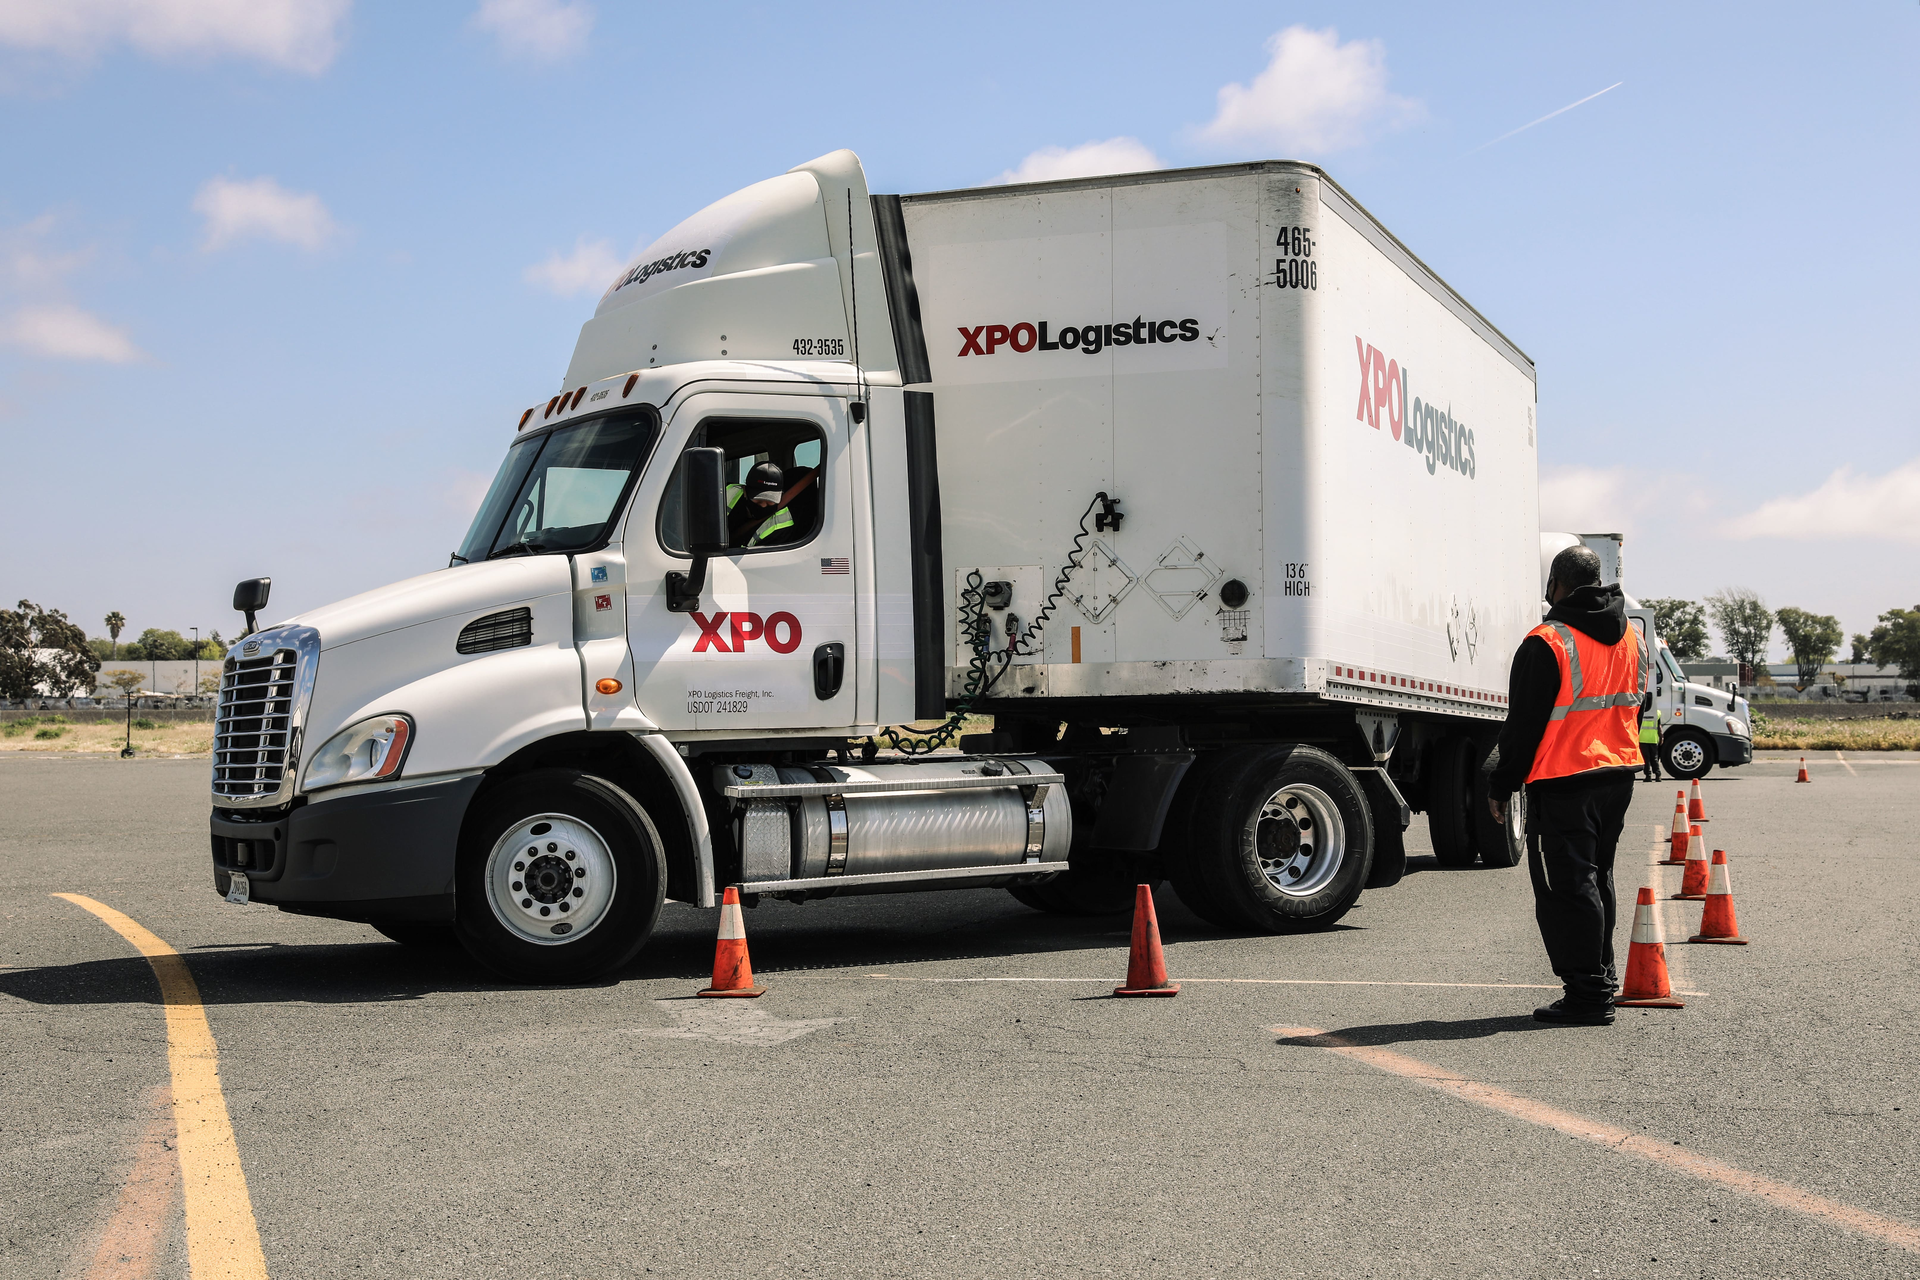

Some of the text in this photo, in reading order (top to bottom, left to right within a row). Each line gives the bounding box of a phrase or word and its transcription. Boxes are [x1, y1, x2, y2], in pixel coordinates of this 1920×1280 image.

[1276, 226, 1316, 257] 465-
[1276, 258, 1317, 291] 5006
[792, 338, 844, 355] 432-3535
[957, 315, 1200, 357] XPOLogistics
[1355, 335, 1475, 480] XPOLogistics
[1284, 580, 1310, 596] HIGH
[688, 611, 802, 654] XPO
[687, 700, 748, 713] USDOT 241829
[688, 690, 774, 700] XPO Logistics Freight, Inc.
